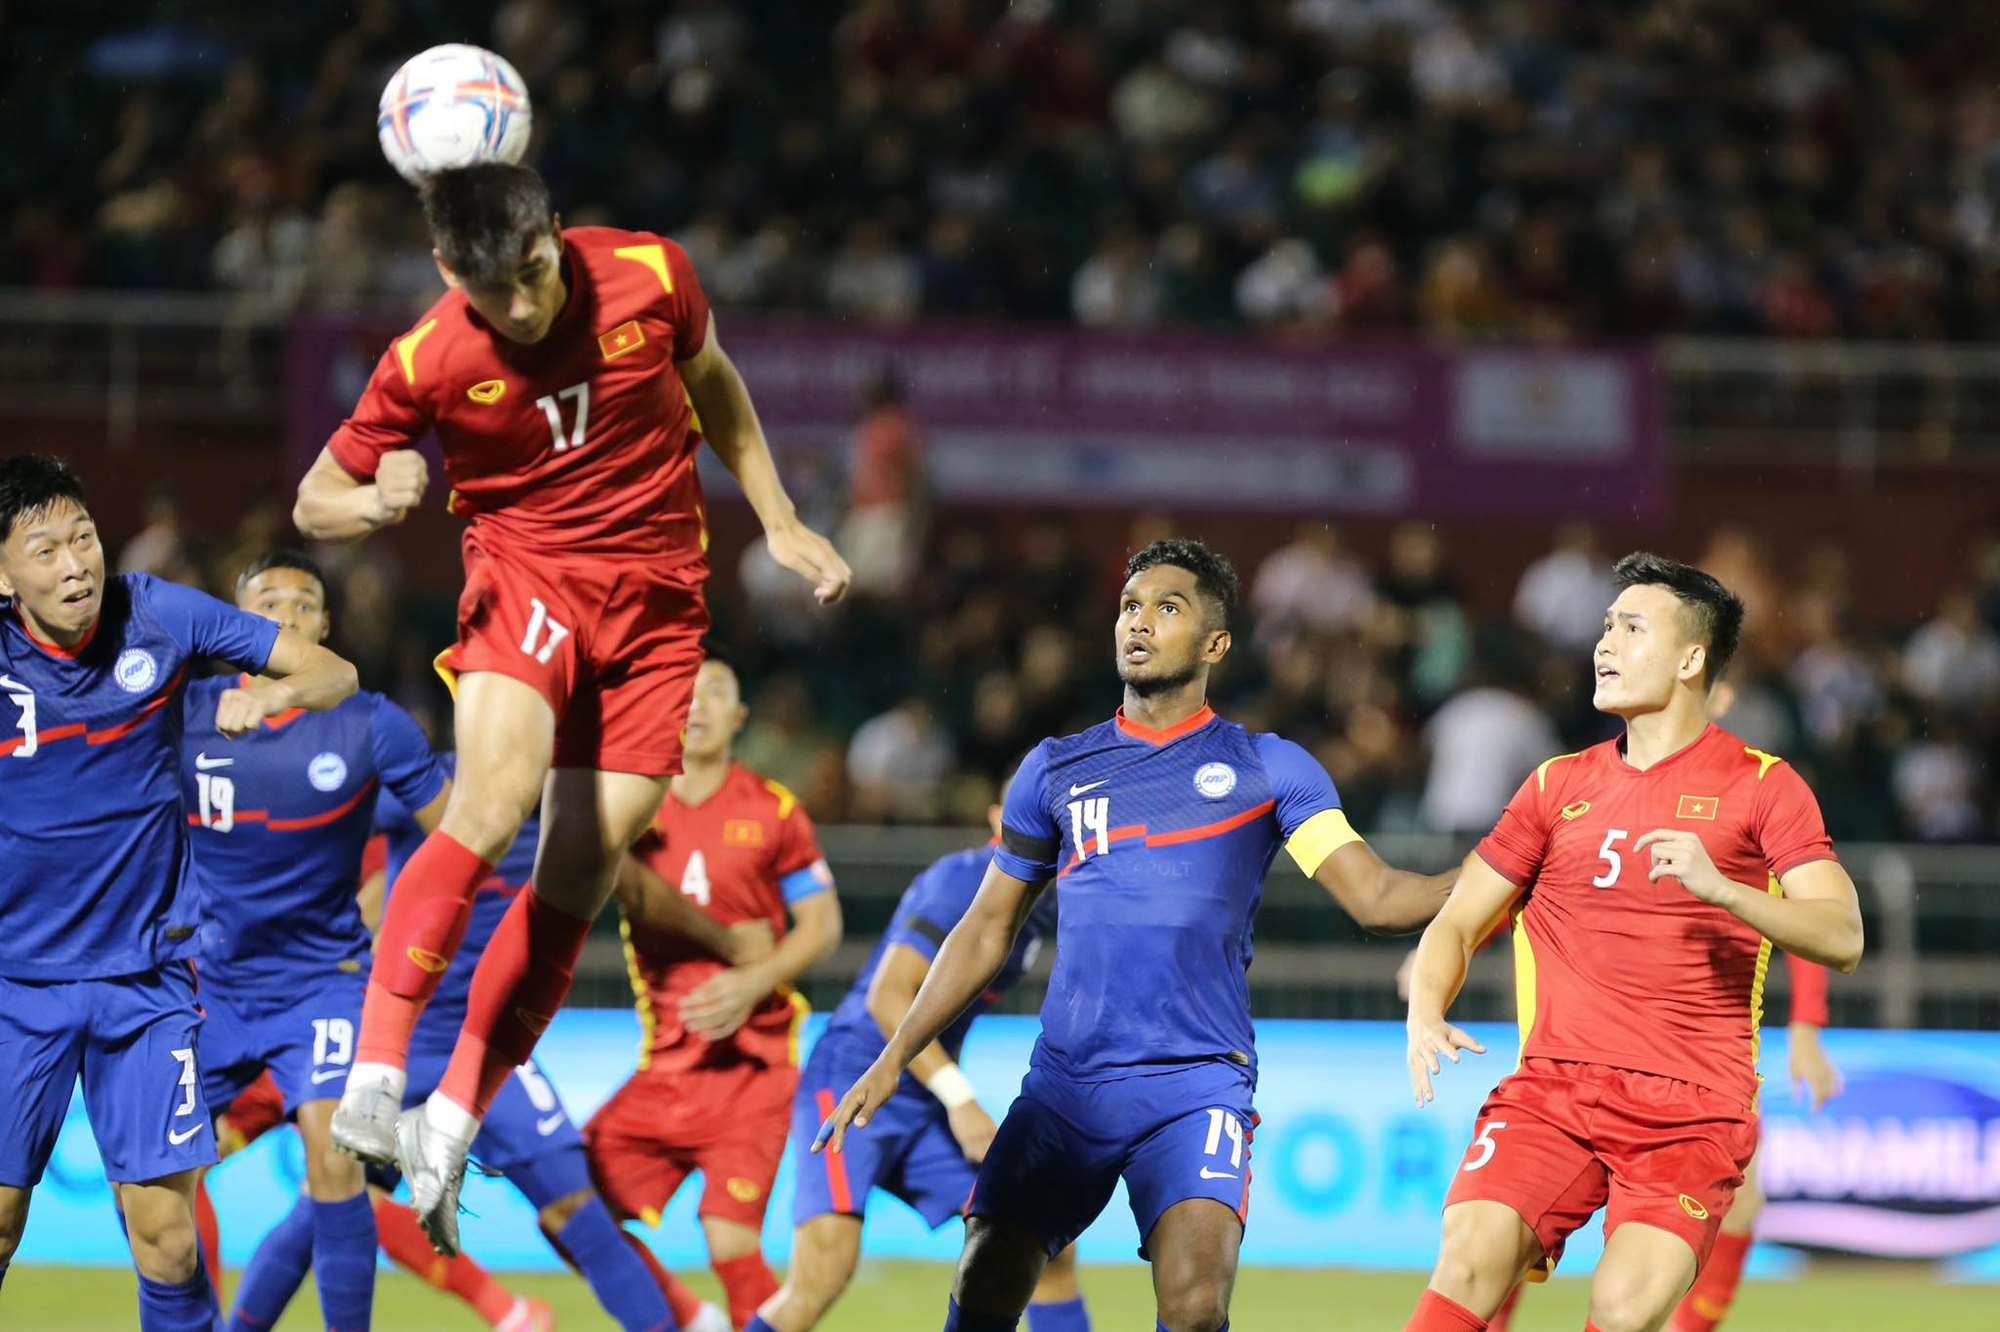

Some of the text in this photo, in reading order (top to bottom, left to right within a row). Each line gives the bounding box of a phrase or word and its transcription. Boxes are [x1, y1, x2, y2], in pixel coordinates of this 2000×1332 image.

[537, 382, 589, 451] 17
[520, 597, 569, 665] 17
[8, 693, 38, 757] 3
[195, 772, 235, 833] 19
[1066, 797, 1110, 861] 14
[680, 849, 711, 906] 4
[1592, 829, 1629, 889] 5
[311, 1018, 354, 1066] 19
[170, 1047, 196, 1117] 3
[1203, 1108, 1243, 1169] 14
[1463, 1121, 1508, 1172] 5
